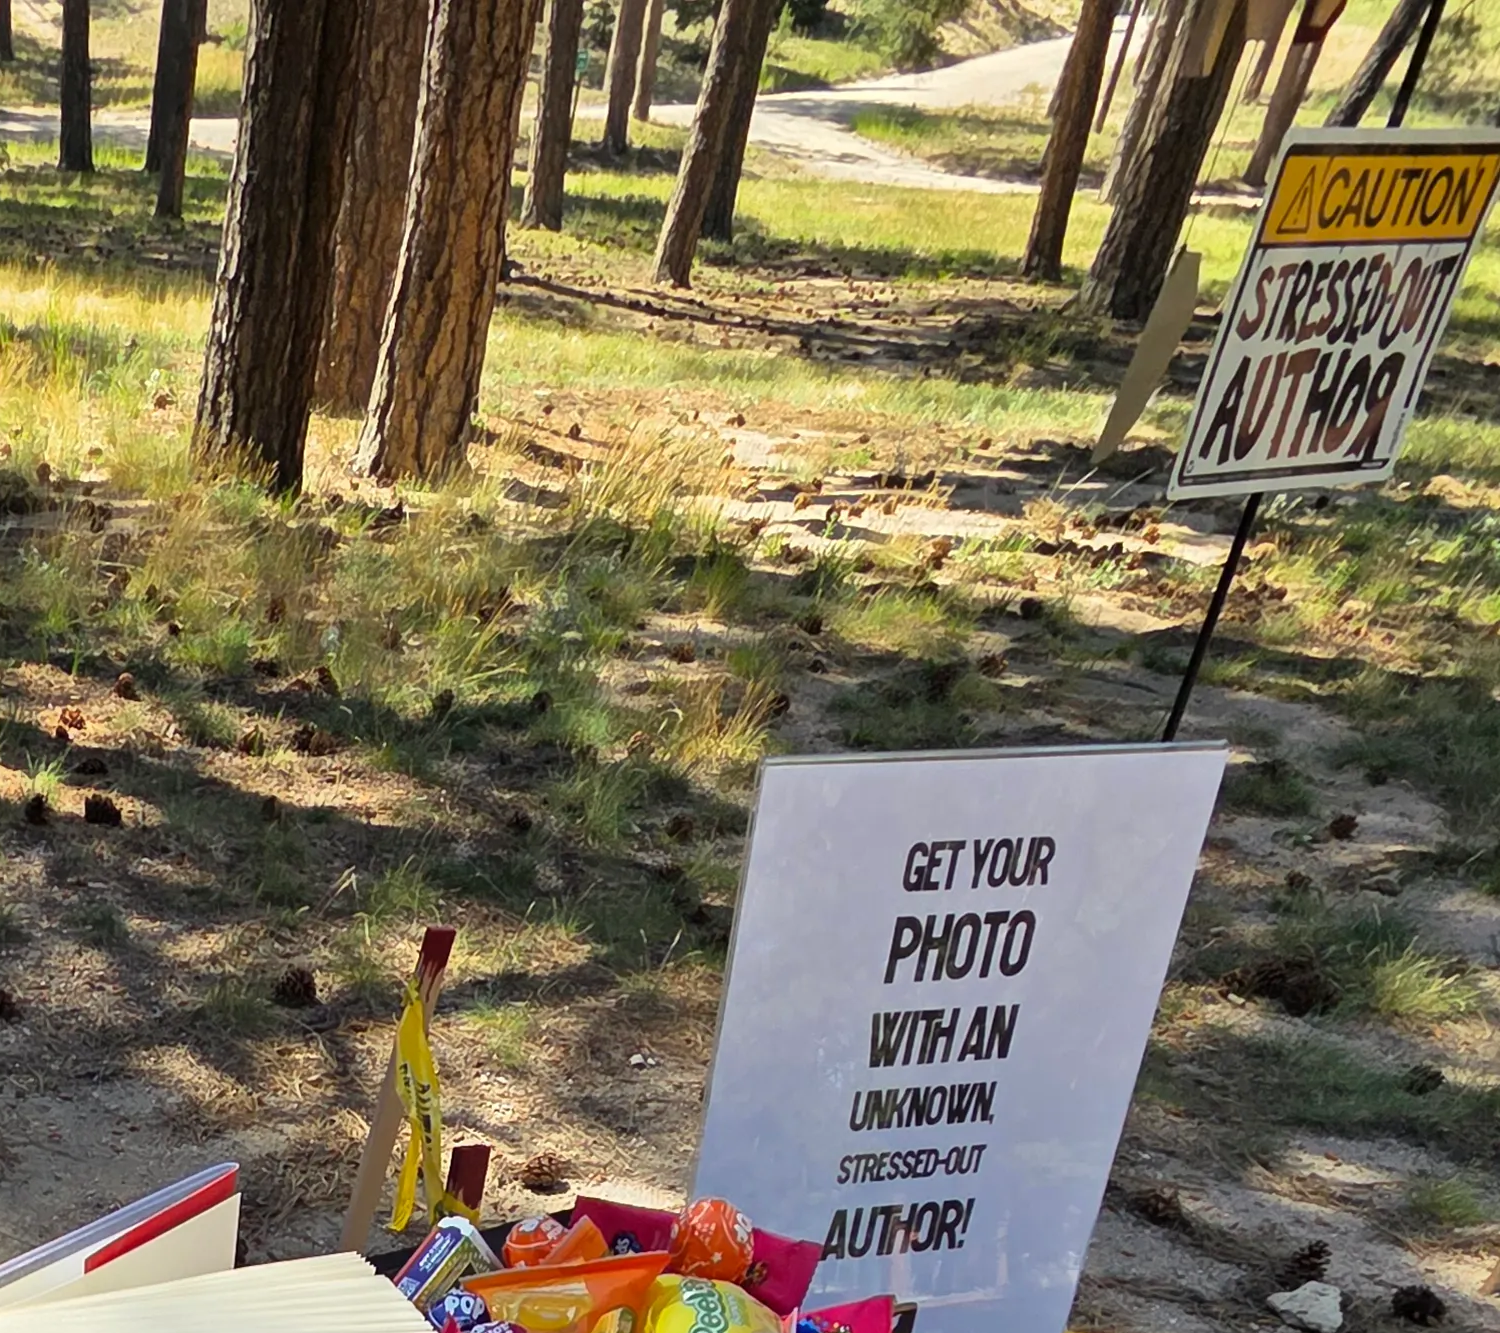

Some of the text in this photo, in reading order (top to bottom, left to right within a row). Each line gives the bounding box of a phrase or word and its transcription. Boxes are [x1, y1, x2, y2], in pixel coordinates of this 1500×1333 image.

[1317, 166, 1485, 229] CAUTION
[1236, 252, 1462, 350] STRESSED-OUT
[902, 835, 1056, 892] GET YOUR
[884, 909, 1037, 984] PHOTO
[868, 1005, 1020, 1068] WITH AN
[848, 1081, 998, 1132] UNKNOWN,
[836, 1144, 987, 1185] STRESSED-OUT
[821, 1198, 975, 1262] AUTHOR!
